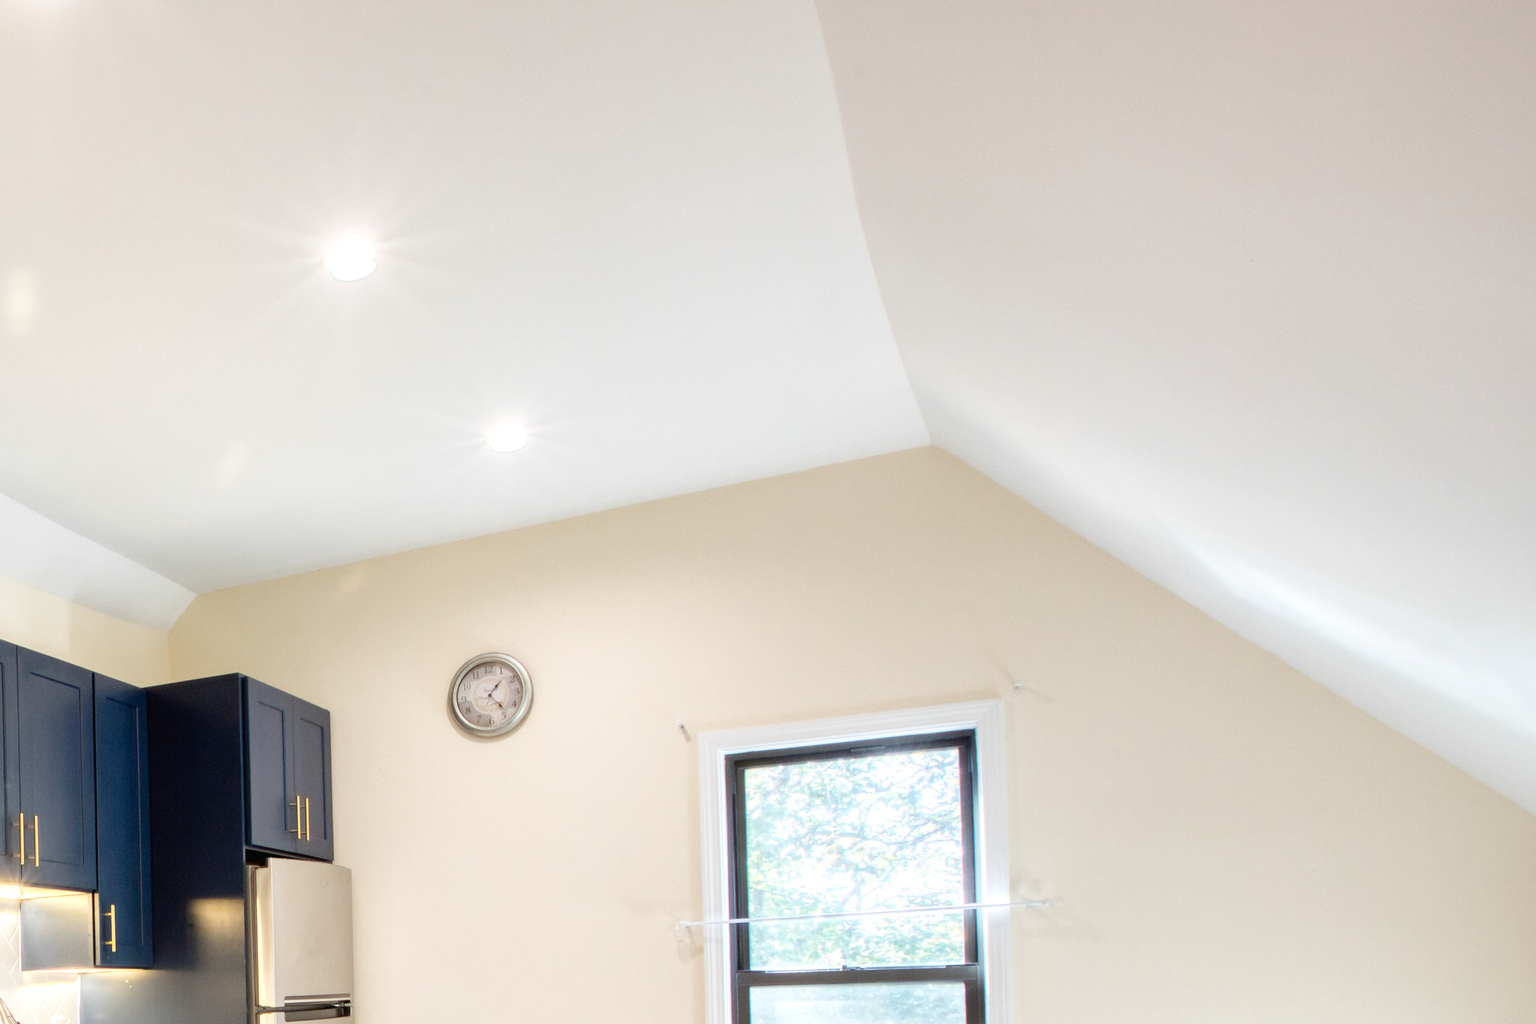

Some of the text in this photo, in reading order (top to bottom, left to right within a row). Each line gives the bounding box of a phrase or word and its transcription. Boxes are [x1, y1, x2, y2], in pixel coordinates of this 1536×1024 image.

[484, 665, 493, 674] 12
[499, 666, 503, 675] 1
[472, 671, 479, 679] 11
[509, 675, 515, 683] 2
[463, 682, 471, 691] 10
[514, 687, 520, 696] 3
[461, 695, 466, 704] 9
[512, 699, 517, 707] 4
[465, 707, 471, 715] 8
[501, 711, 506, 720] 5
[476, 714, 481, 723] 7
[489, 717, 495, 725] 6
